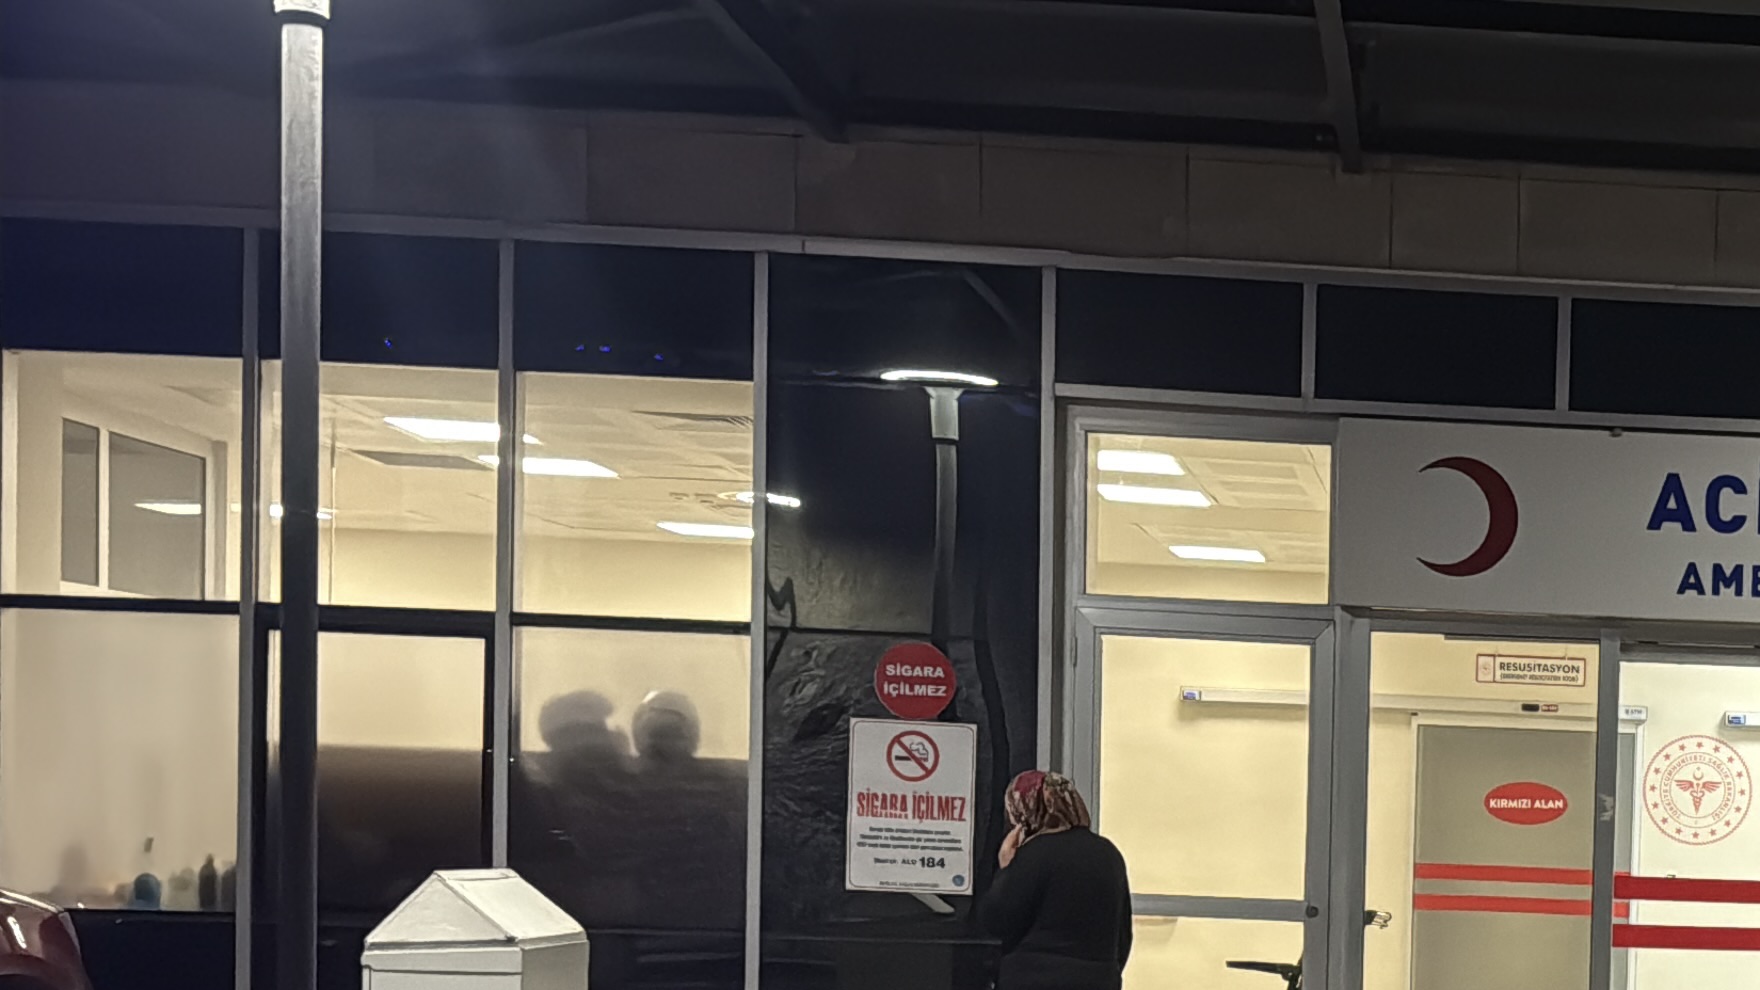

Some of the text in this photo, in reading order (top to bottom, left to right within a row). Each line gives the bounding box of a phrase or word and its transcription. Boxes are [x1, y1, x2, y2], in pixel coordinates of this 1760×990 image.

[885, 662, 945, 678] SİGARA
[883, 681, 947, 697] İÇİLMEZ
[857, 787, 966, 823] SİGARA İÇİLMEZ
[1489, 798, 1564, 809] KIRMIZI ALAN
[919, 857, 946, 868] 184
